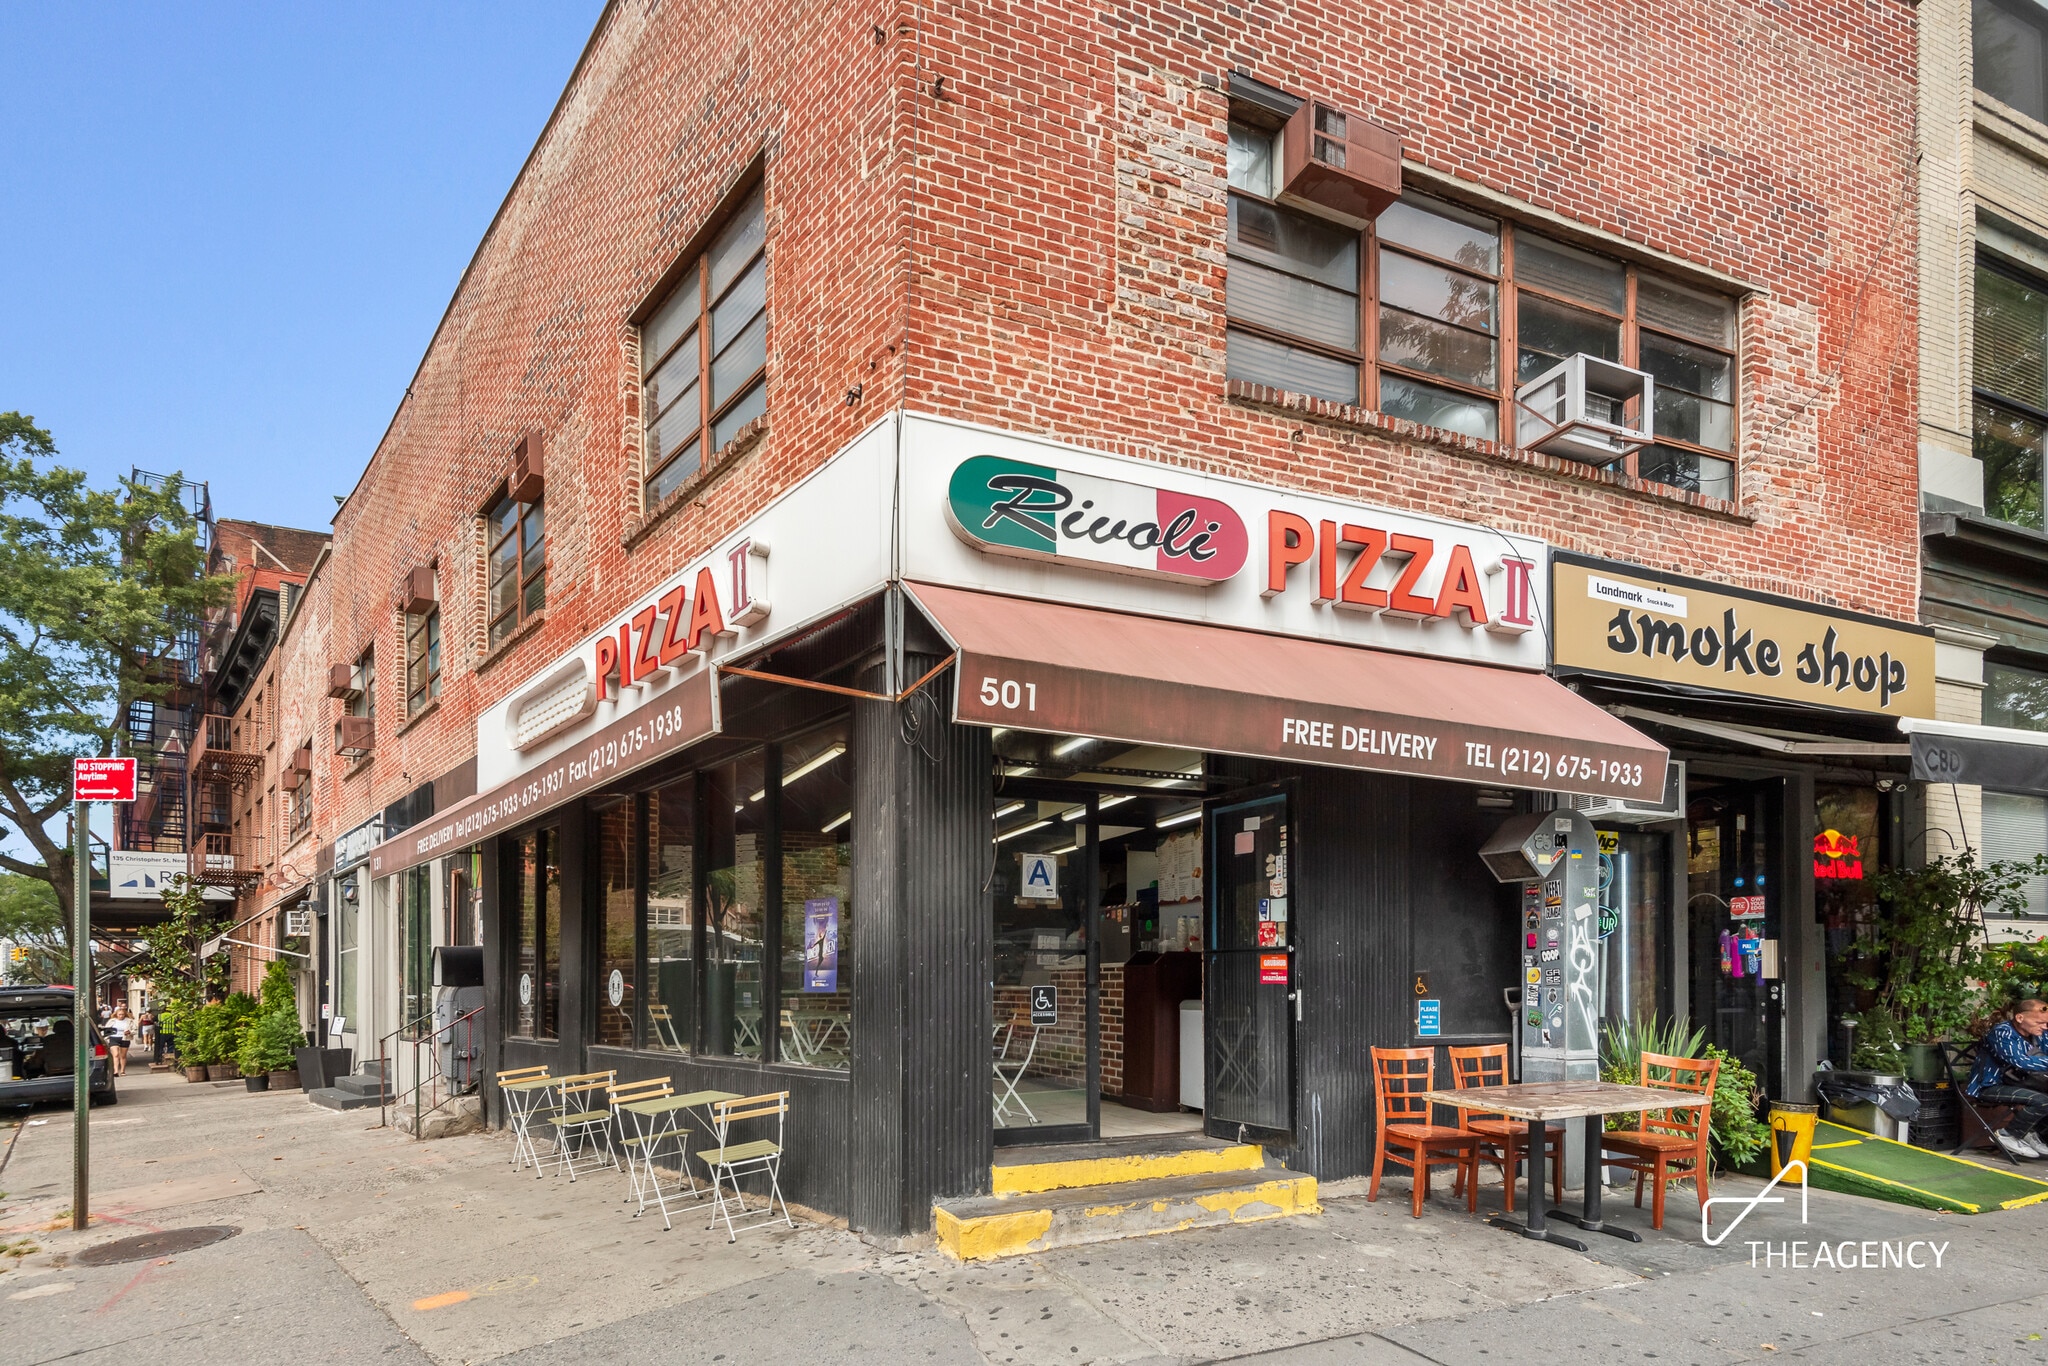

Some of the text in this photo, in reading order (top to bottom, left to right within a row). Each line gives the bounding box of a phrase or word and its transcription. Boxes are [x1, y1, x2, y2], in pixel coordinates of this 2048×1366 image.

[982, 474, 1220, 562] Rivoli
[1264, 509, 1489, 625] PIZZA
[1596, 582, 1643, 602] Landmark
[596, 566, 725, 702] PIZZA
[1607, 608, 1907, 708] smoke shop
[980, 676, 1036, 711] 501
[1282, 717, 1642, 787] FREE DELIVERY TEL (212) 675-1933
[1924, 748, 1961, 772] CBD
[77, 762, 125, 771] NO STOPPING
[77, 772, 108, 782] Anytime
[416, 835, 429, 855] FREE
[429, 823, 454, 850] DELIVERY
[455, 819, 465, 838] Tel
[465, 811, 483, 838] (212)
[569, 759, 588, 783] Fax
[588, 740, 618, 779] (212)
[620, 705, 682, 758] 675-1938
[125, 855, 162, 863] Christopher
[1028, 859, 1051, 886] A
[1836, 859, 1863, 880] Bull
